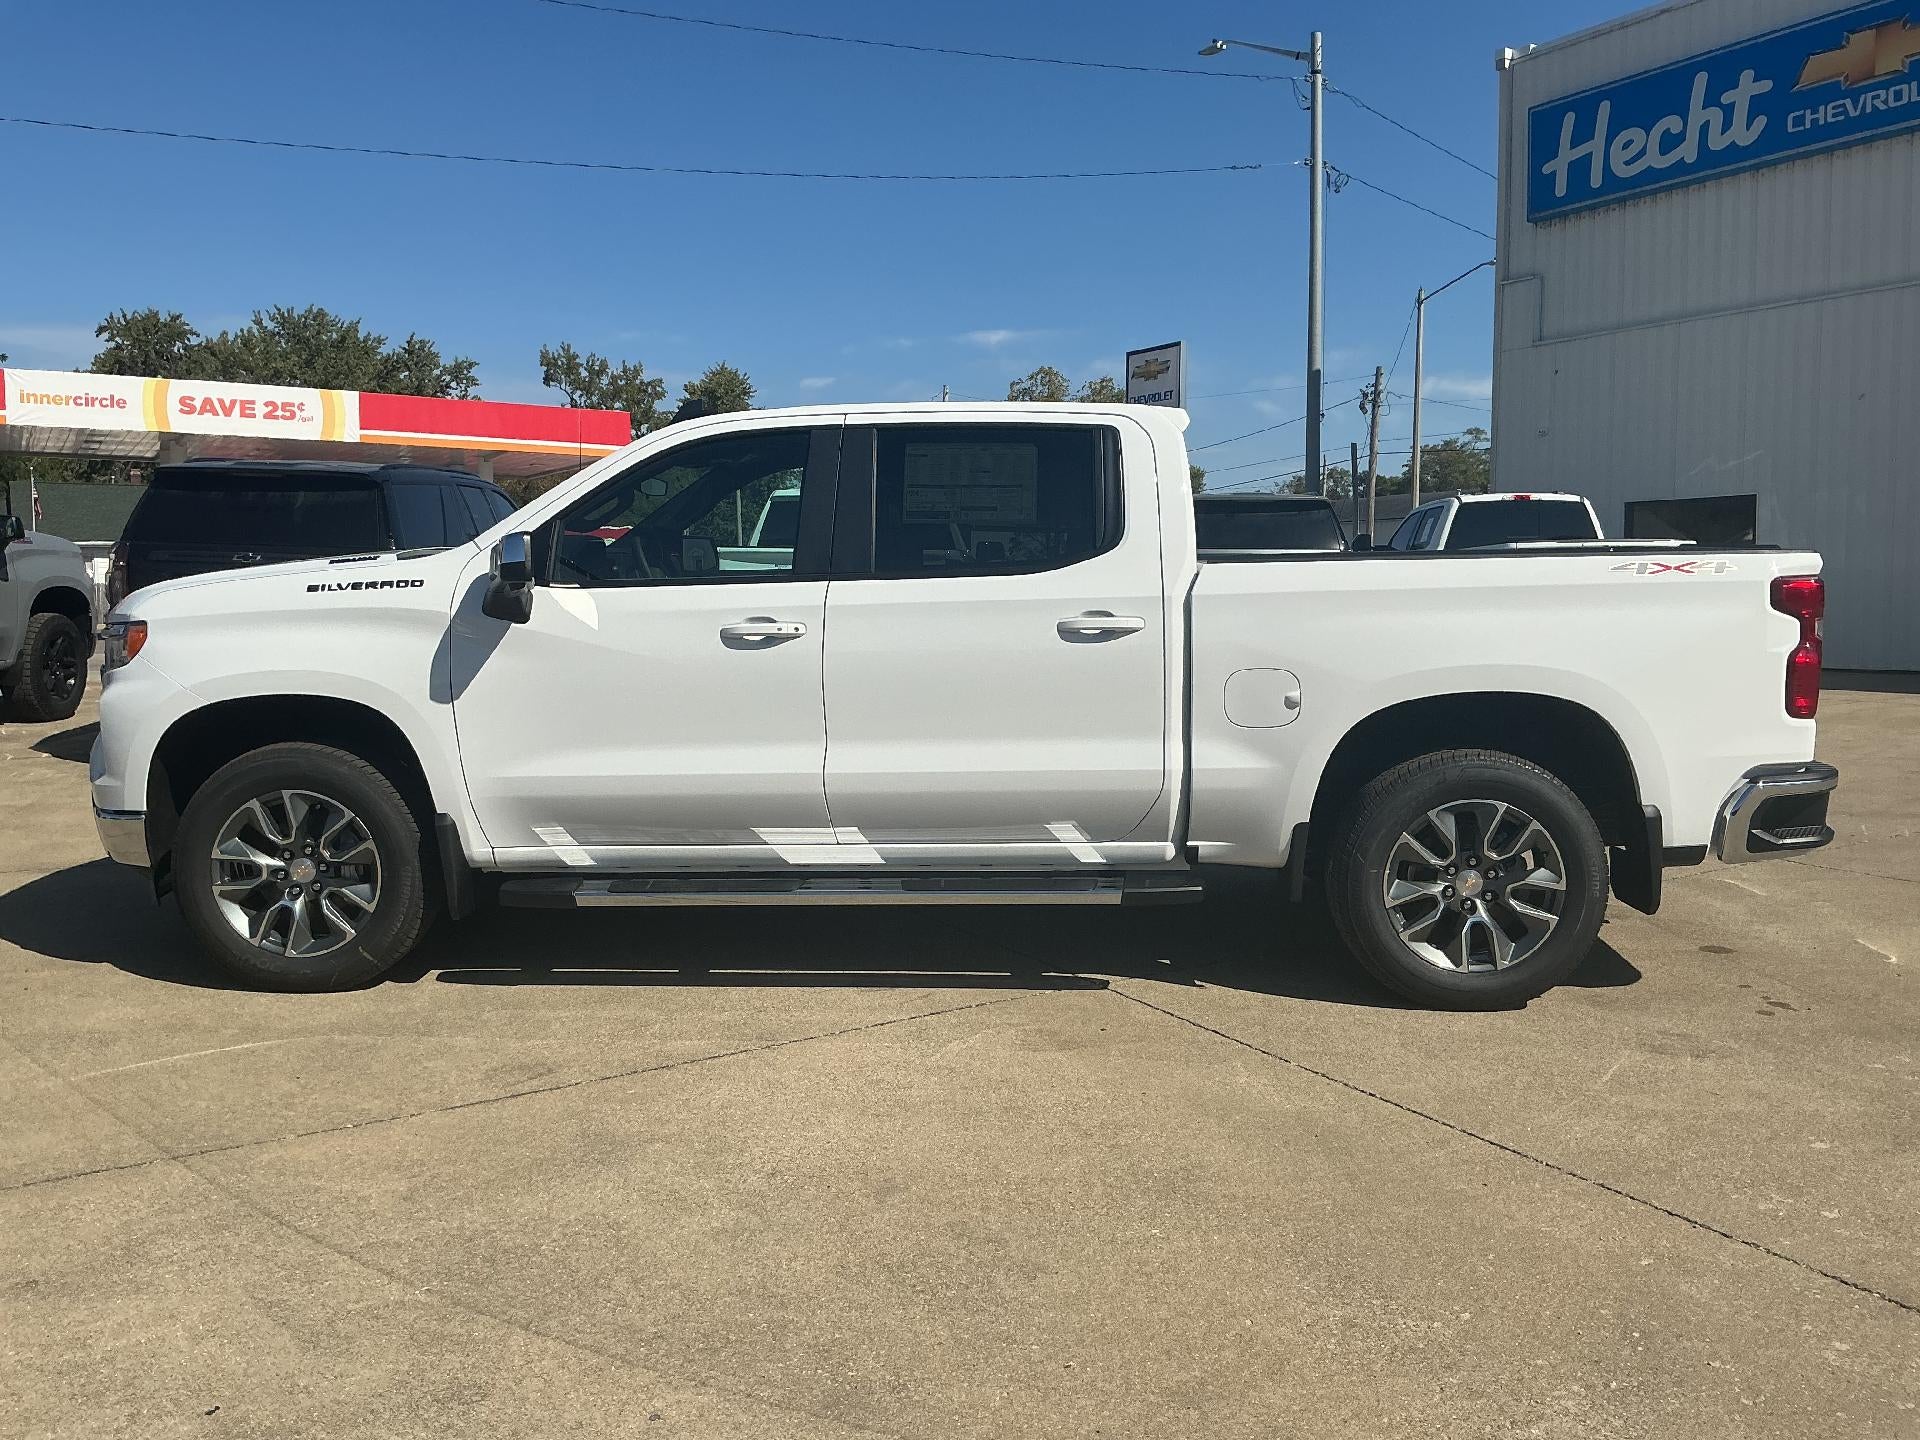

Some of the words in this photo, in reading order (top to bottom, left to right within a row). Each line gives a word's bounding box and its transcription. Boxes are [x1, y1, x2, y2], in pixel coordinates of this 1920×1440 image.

[1542, 69, 1774, 198] Hecht
[19, 389, 128, 409] innercircle
[178, 395, 257, 419] SAVE
[1129, 390, 1174, 404] CHEVROLET
[306, 579, 425, 593] SILVERADO
